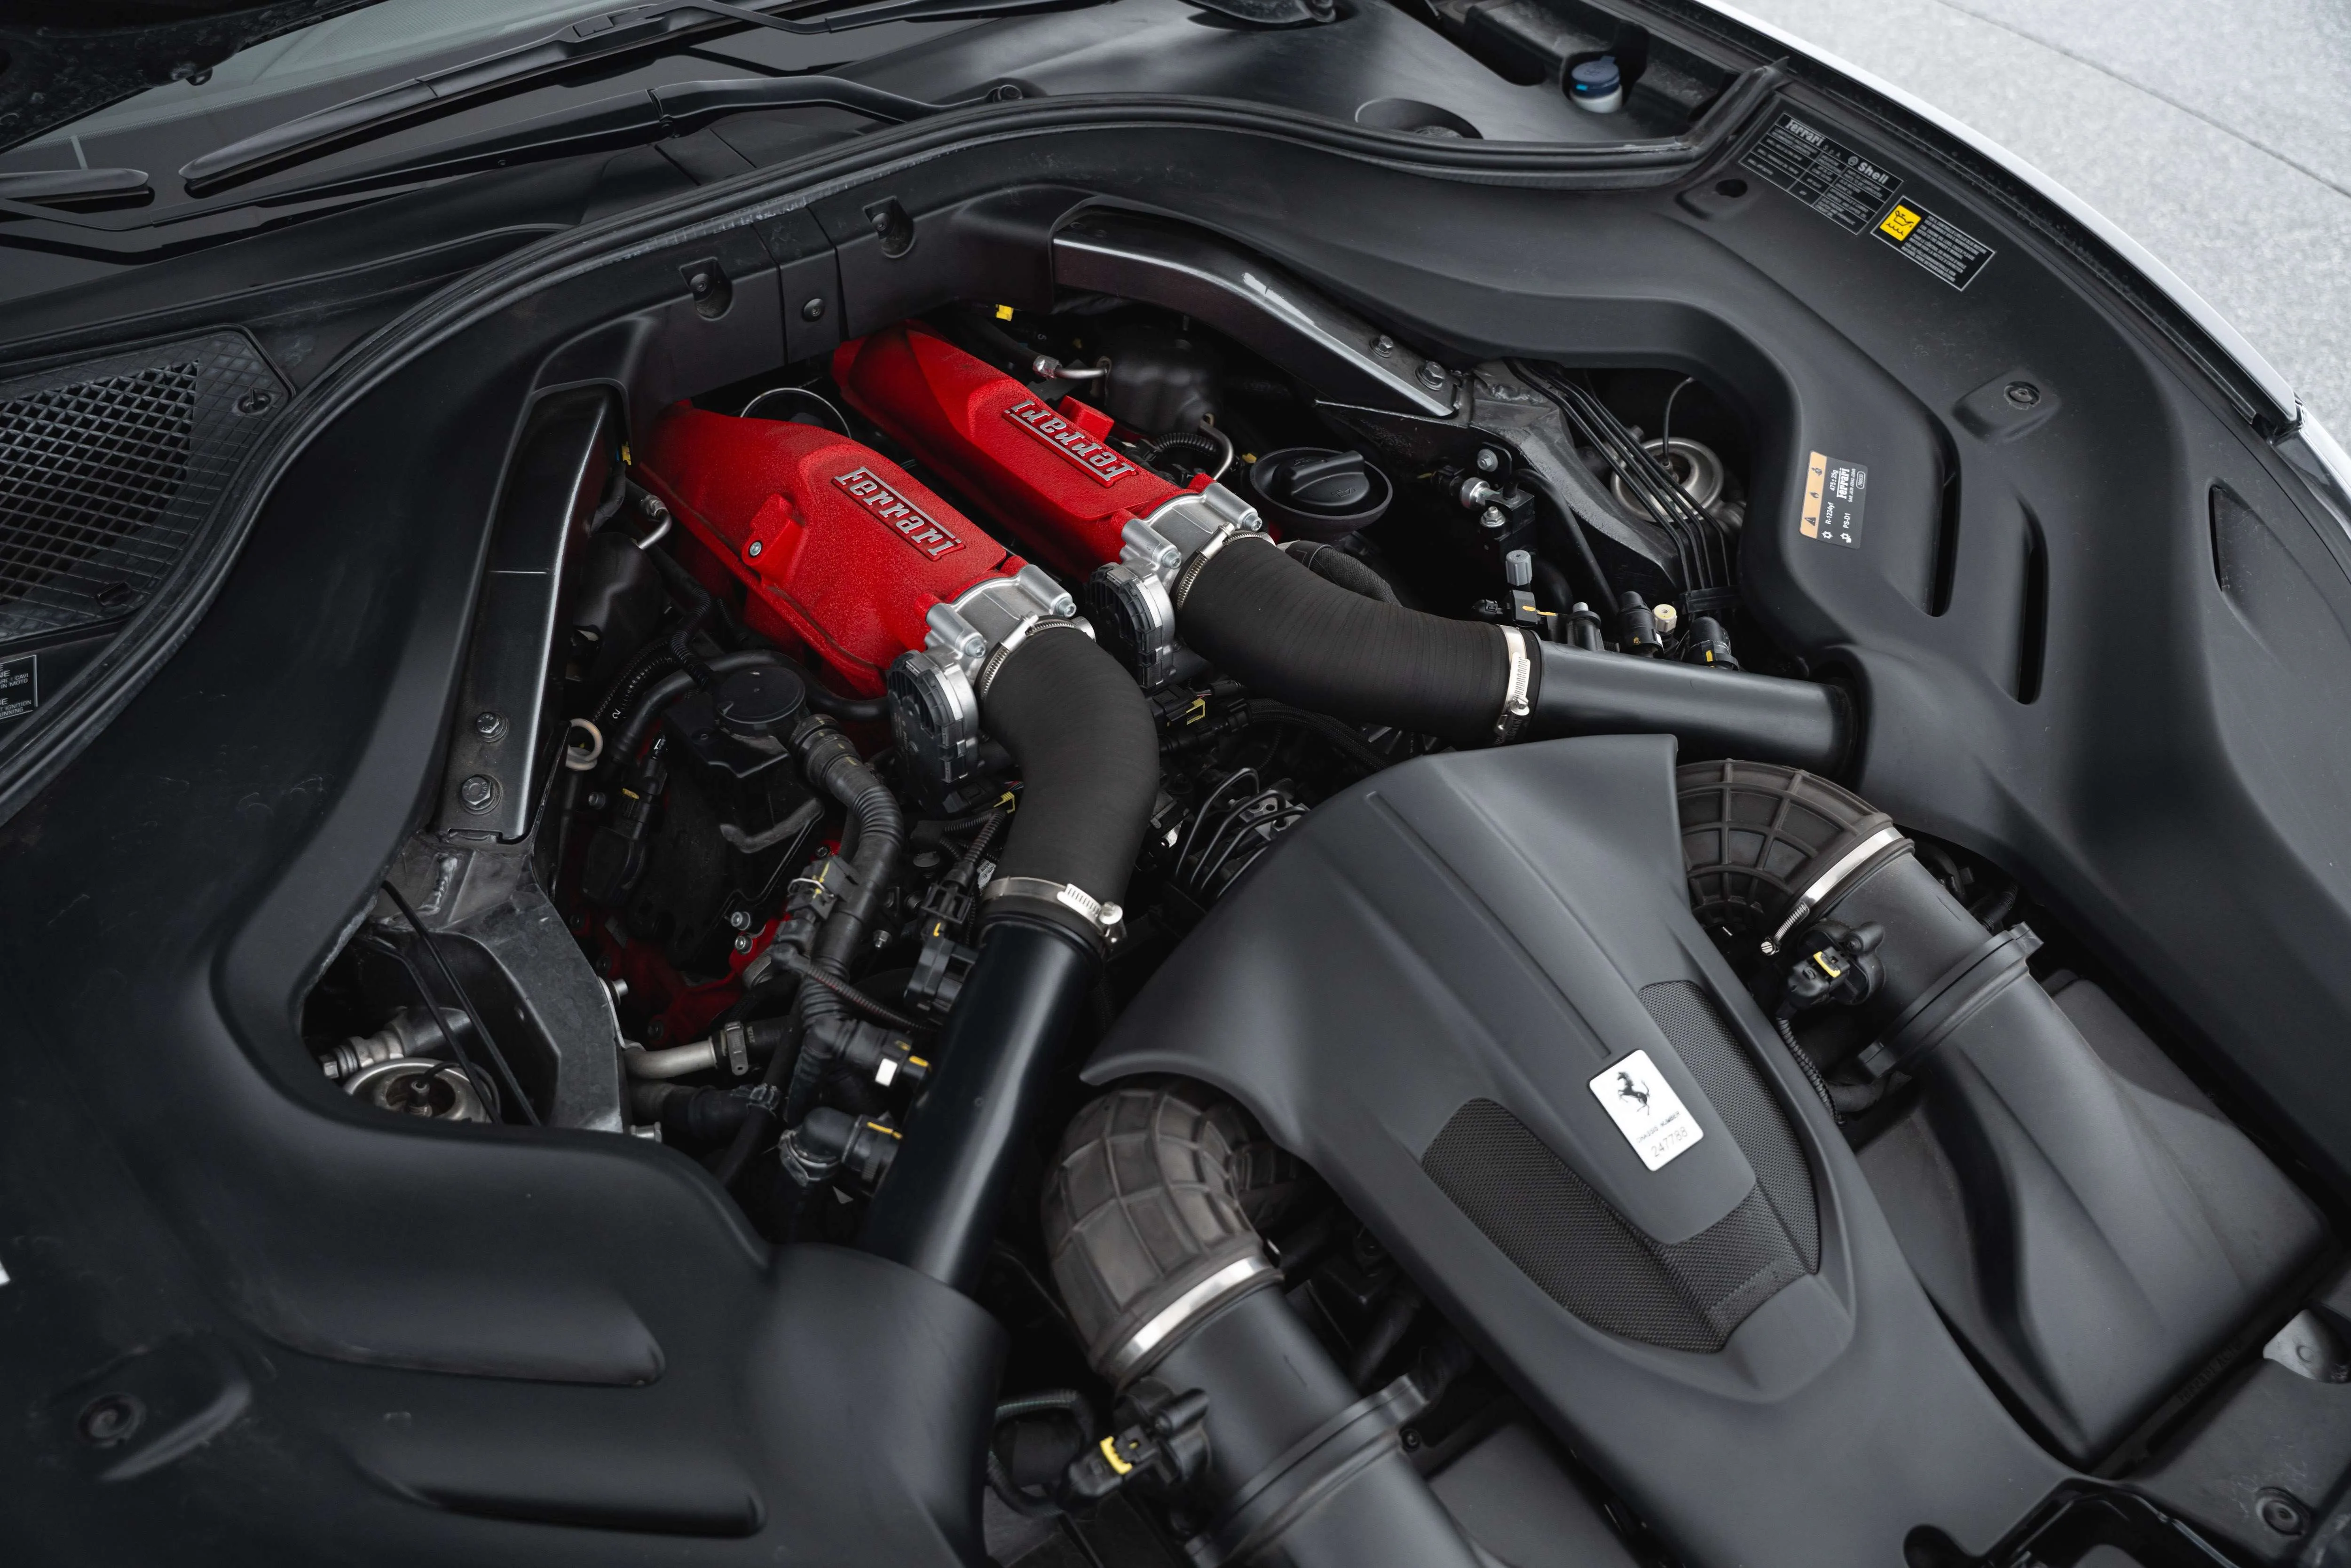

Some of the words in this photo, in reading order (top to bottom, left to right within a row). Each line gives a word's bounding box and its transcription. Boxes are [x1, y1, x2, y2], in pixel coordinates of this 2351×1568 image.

[1785, 119, 1825, 146] Ferrari
[1858, 162, 1889, 184] Shell
[1003, 400, 1136, 482] Ferrari
[1837, 467, 1850, 499] Ferrari
[837, 466, 962, 556] Ferrari
[1825, 502, 1835, 525] R-1234yf
[10, 678, 28, 687] MOTO
[5, 700, 32, 710] IGNITION
[1651, 1127, 1688, 1158] 247788
